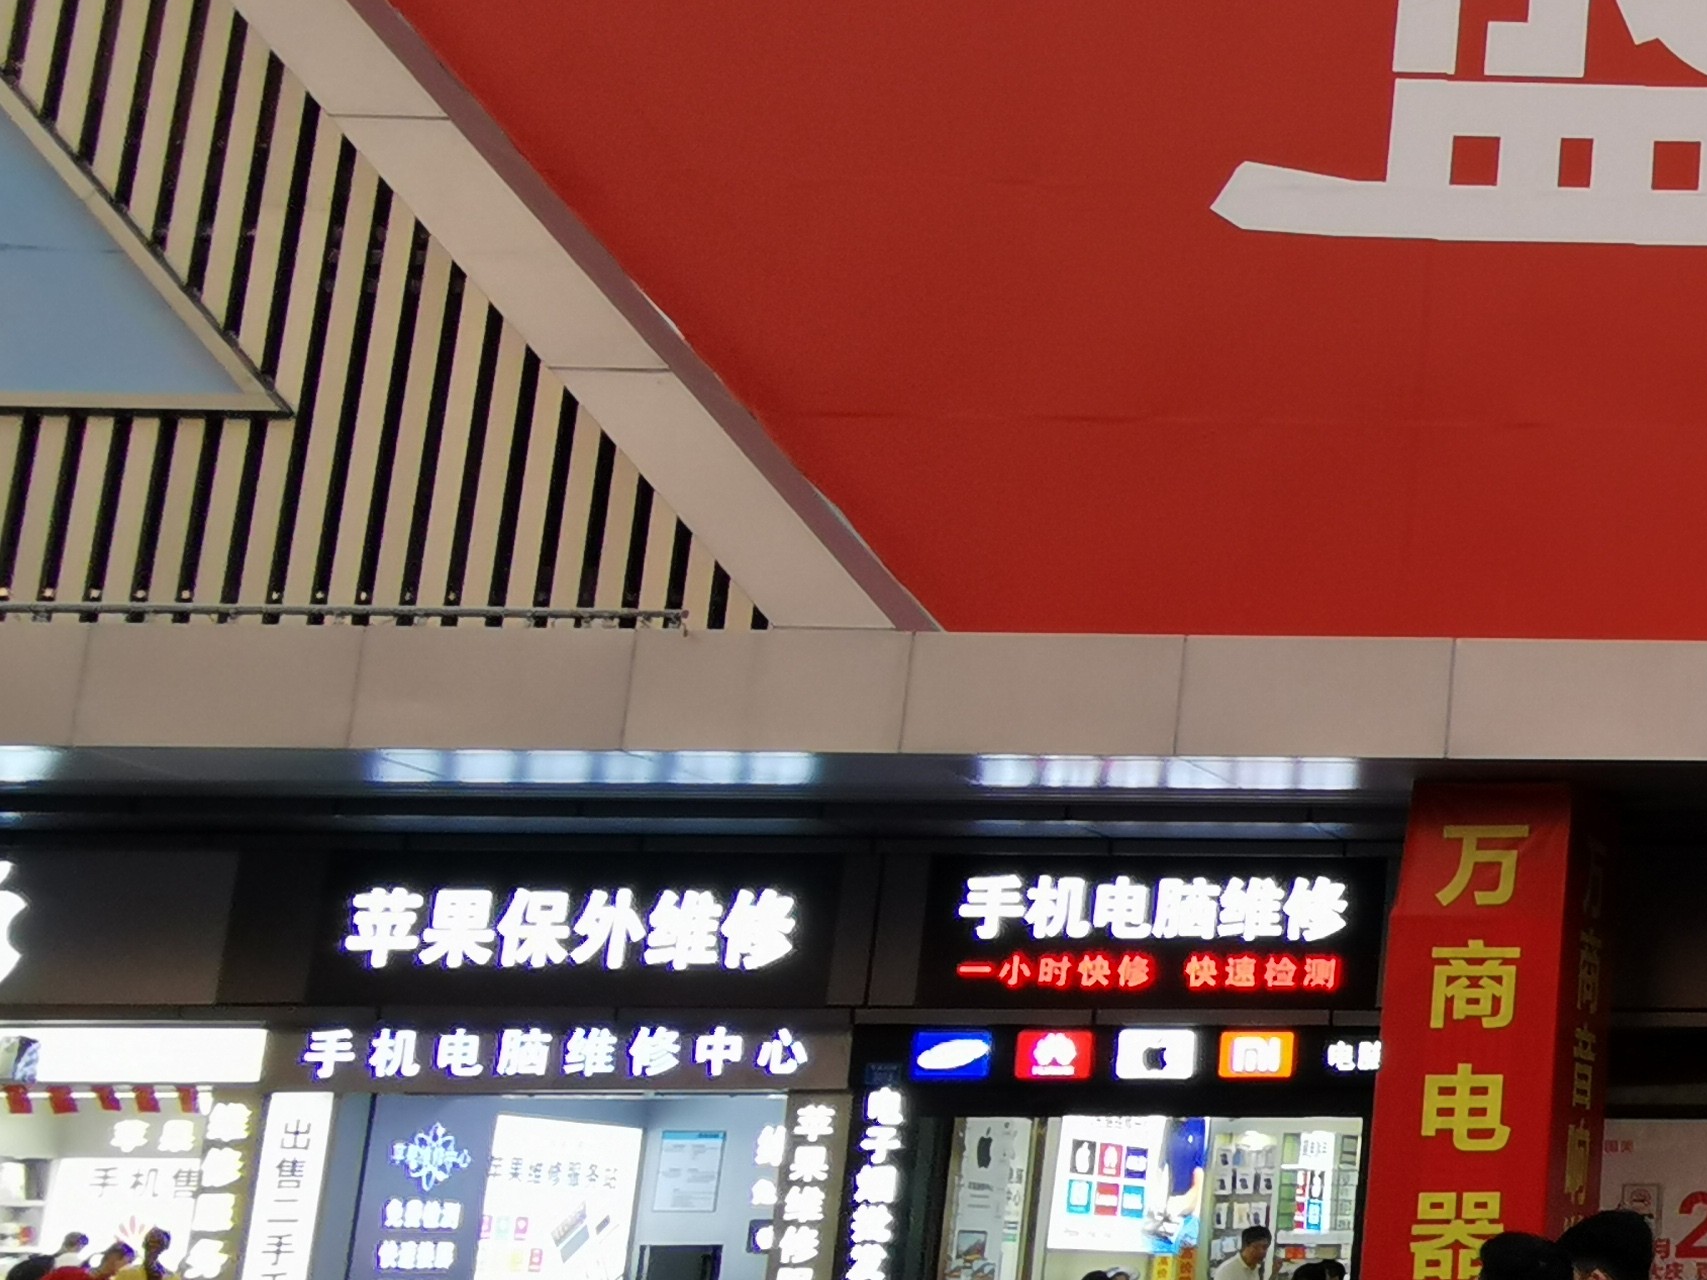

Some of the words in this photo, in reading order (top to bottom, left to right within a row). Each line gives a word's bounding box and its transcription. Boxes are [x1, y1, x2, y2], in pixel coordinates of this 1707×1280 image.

[344, 885, 798, 971] 苹果保外维修
[957, 874, 1348, 942] 手机电脑维修
[957, 954, 1153, 989] 一小时快修
[1184, 954, 1338, 990] 快速检测
[302, 1026, 808, 1079] 手机电脑维修中心
